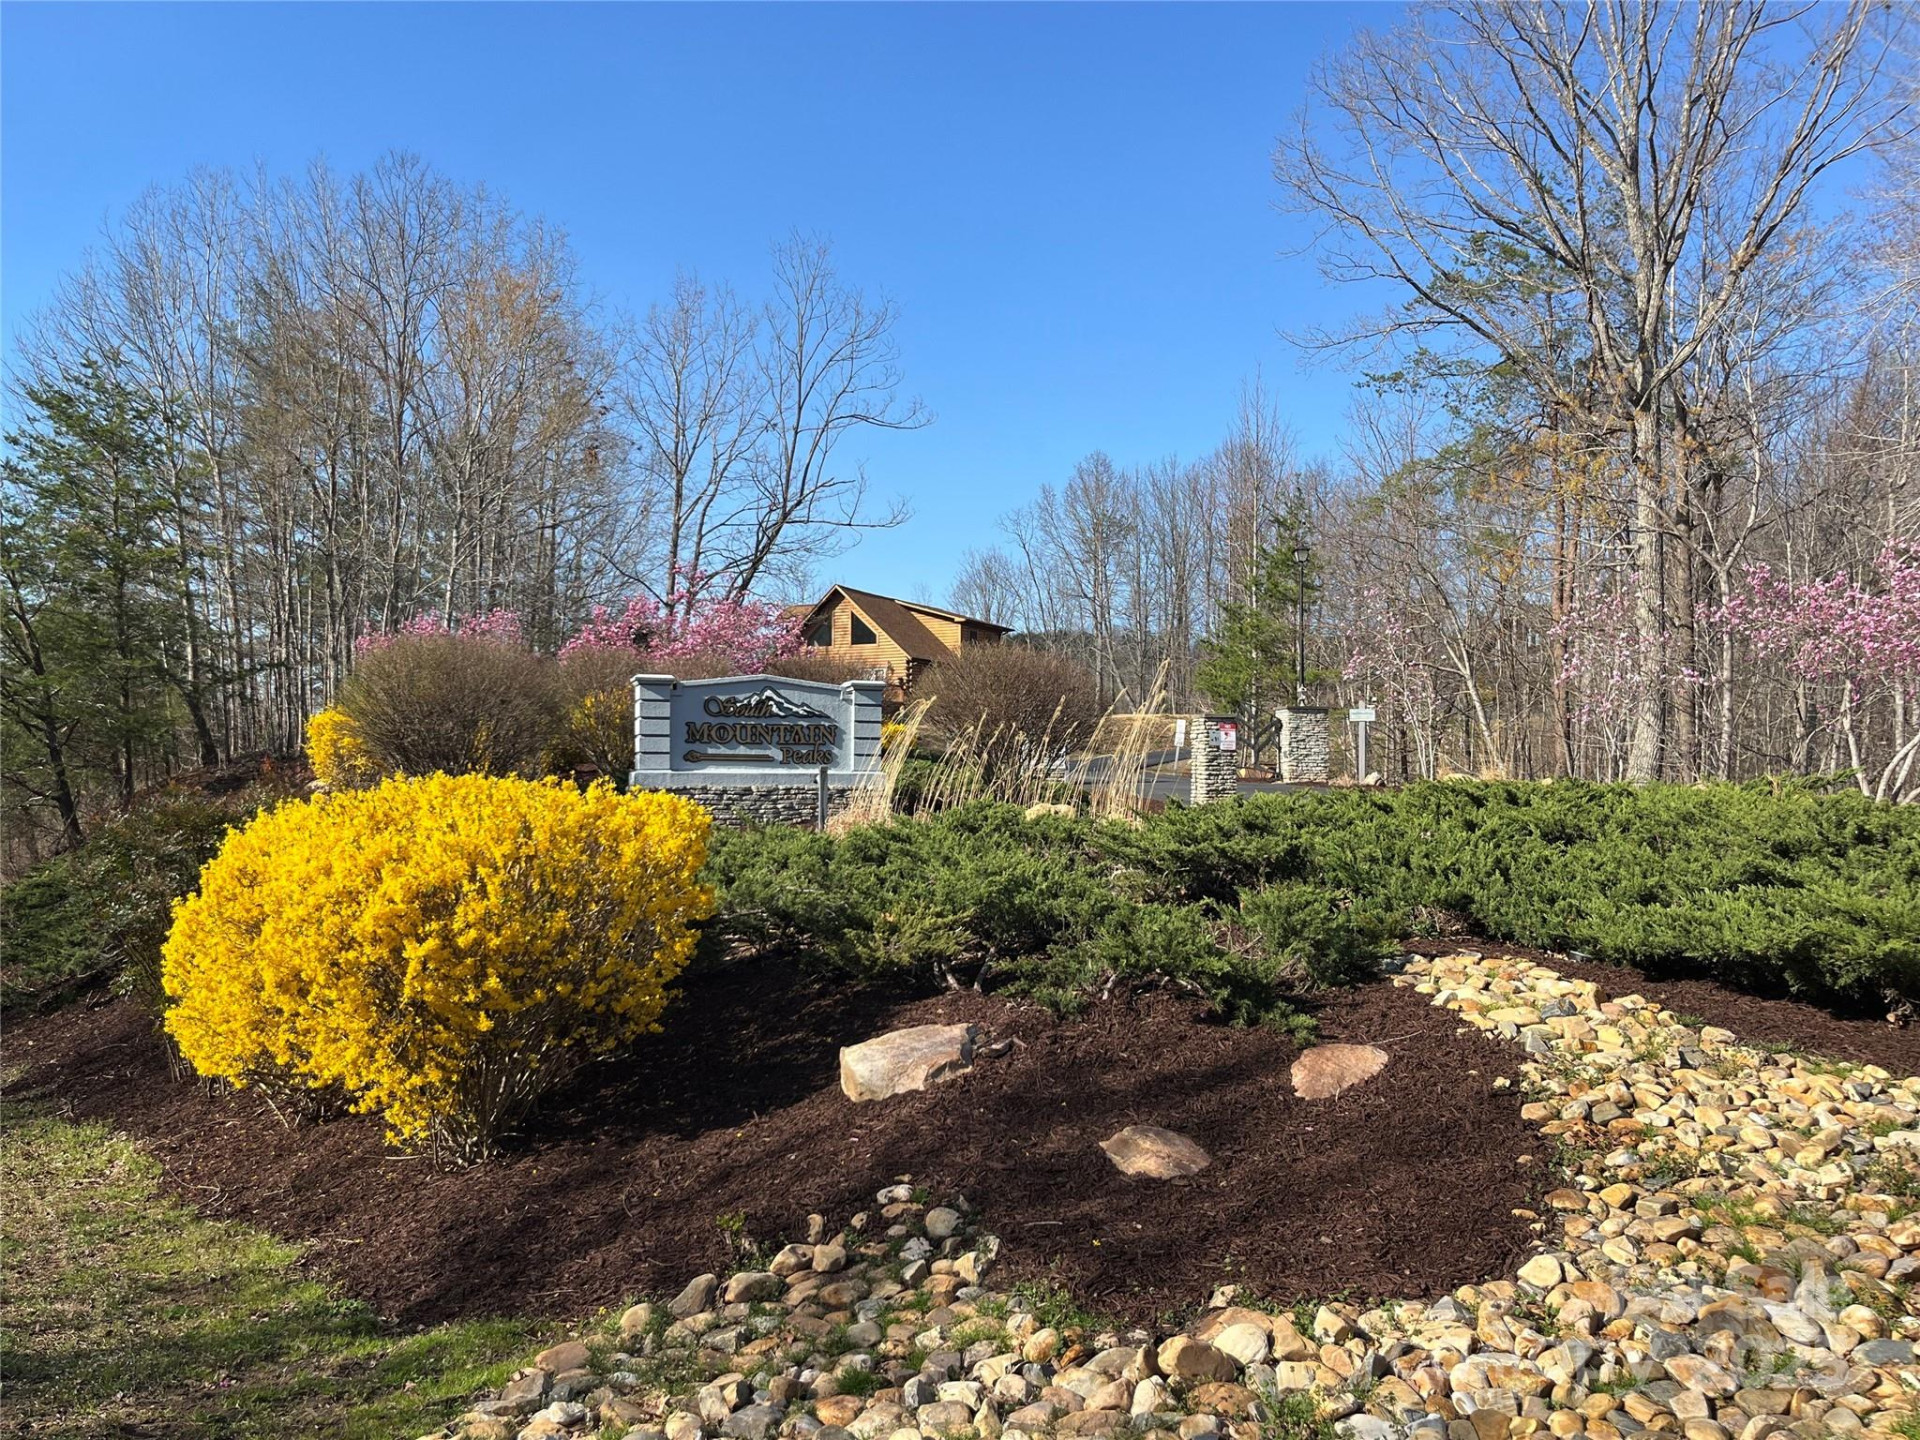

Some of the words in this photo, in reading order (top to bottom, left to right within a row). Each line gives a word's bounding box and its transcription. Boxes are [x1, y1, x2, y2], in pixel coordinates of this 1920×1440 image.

[704, 695, 773, 718] South
[685, 722, 838, 744] MOUNTAIN
[780, 742, 834, 764] Peaks
